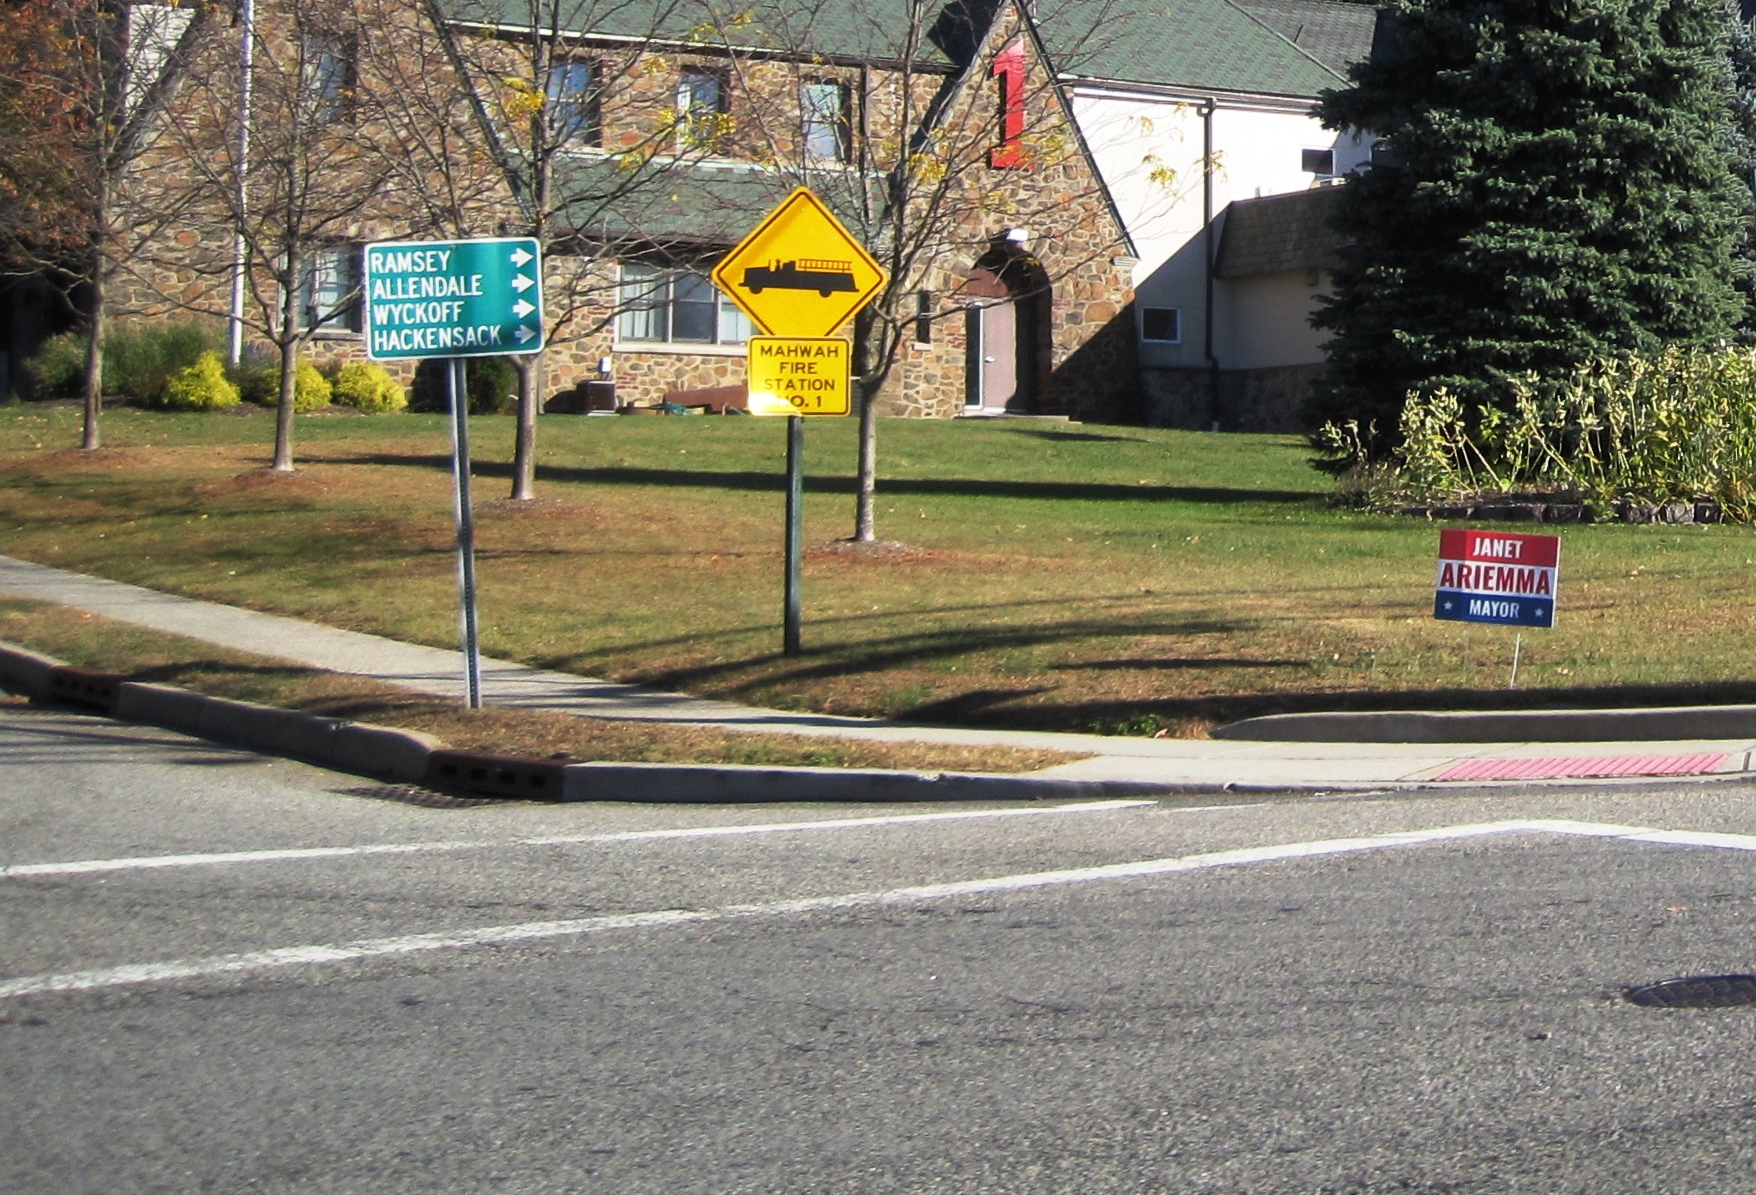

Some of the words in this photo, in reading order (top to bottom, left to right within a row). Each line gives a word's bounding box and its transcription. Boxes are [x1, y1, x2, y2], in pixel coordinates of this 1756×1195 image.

[991, 40, 1035, 169] 1
[371, 251, 450, 273] RAMSEY
[373, 274, 483, 299] ALLENDALE
[374, 301, 464, 325] WYCKOFF
[374, 325, 501, 351] HACKENSACK
[760, 345, 838, 357] MAHWAH
[780, 362, 818, 374] FIRE
[765, 379, 835, 391] STATION
[816, 396, 822, 408] 1
[1473, 538, 1523, 558] JANET
[1440, 562, 1550, 595] ARIEMMA
[1469, 599, 1520, 618] MAYOR
